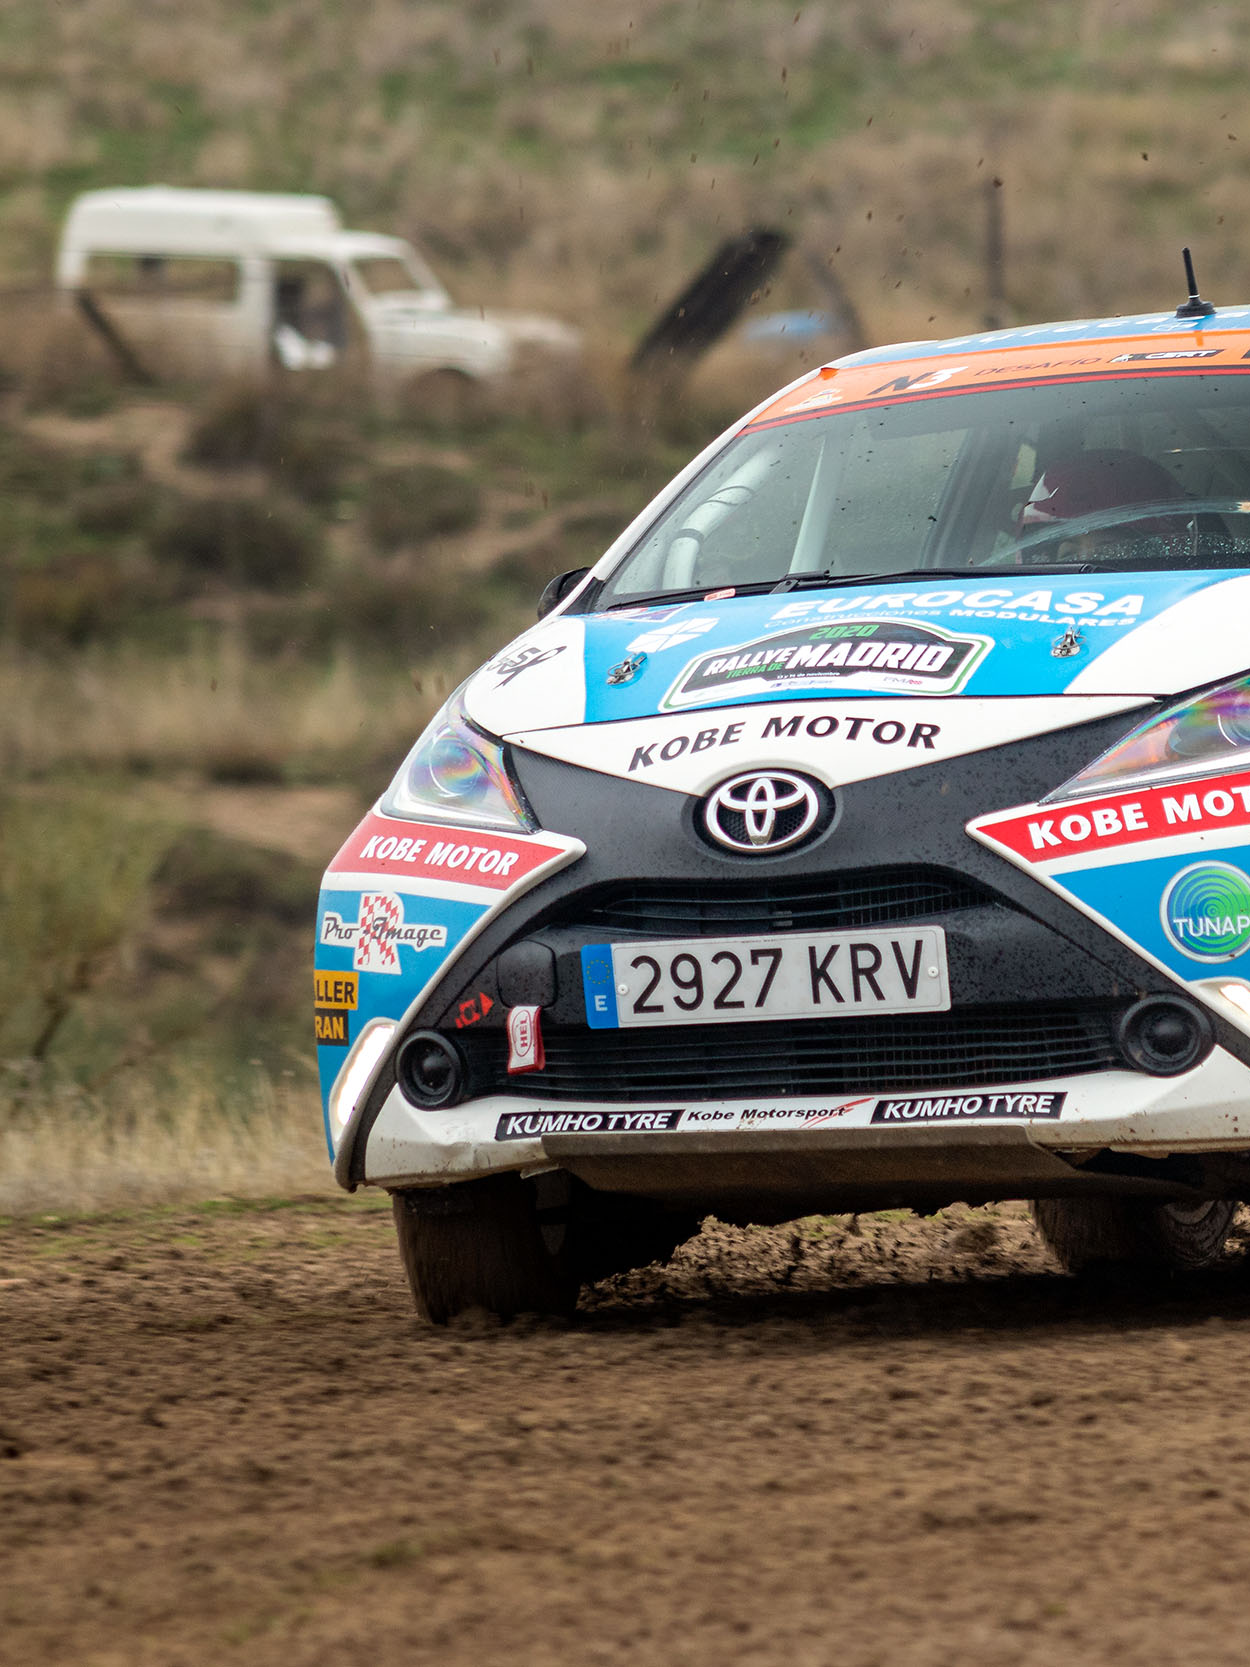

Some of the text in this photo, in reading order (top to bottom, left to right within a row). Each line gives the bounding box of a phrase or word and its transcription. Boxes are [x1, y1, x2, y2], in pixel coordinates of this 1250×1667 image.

[769, 589, 1145, 621] EUROCASA
[949, 608, 1137, 627] MODULARES
[808, 624, 880, 641] 2020
[702, 641, 955, 677] RALLYE MADRID
[725, 661, 785, 679] TIERRA DE
[628, 715, 941, 772] KOBE MOTOR
[1027, 803, 1149, 850] KOBE
[360, 835, 520, 876] KOBE MOTOR
[324, 916, 360, 941] Pro
[630, 939, 923, 1014] 2927 KRV
[594, 995, 608, 1011] E
[519, 1015, 529, 1048] HEL
[686, 1105, 846, 1122] Kobe Motorsport
[883, 1093, 1052, 1120] KUMHO TYRE
[506, 1112, 671, 1136] KUMHO TYRE
